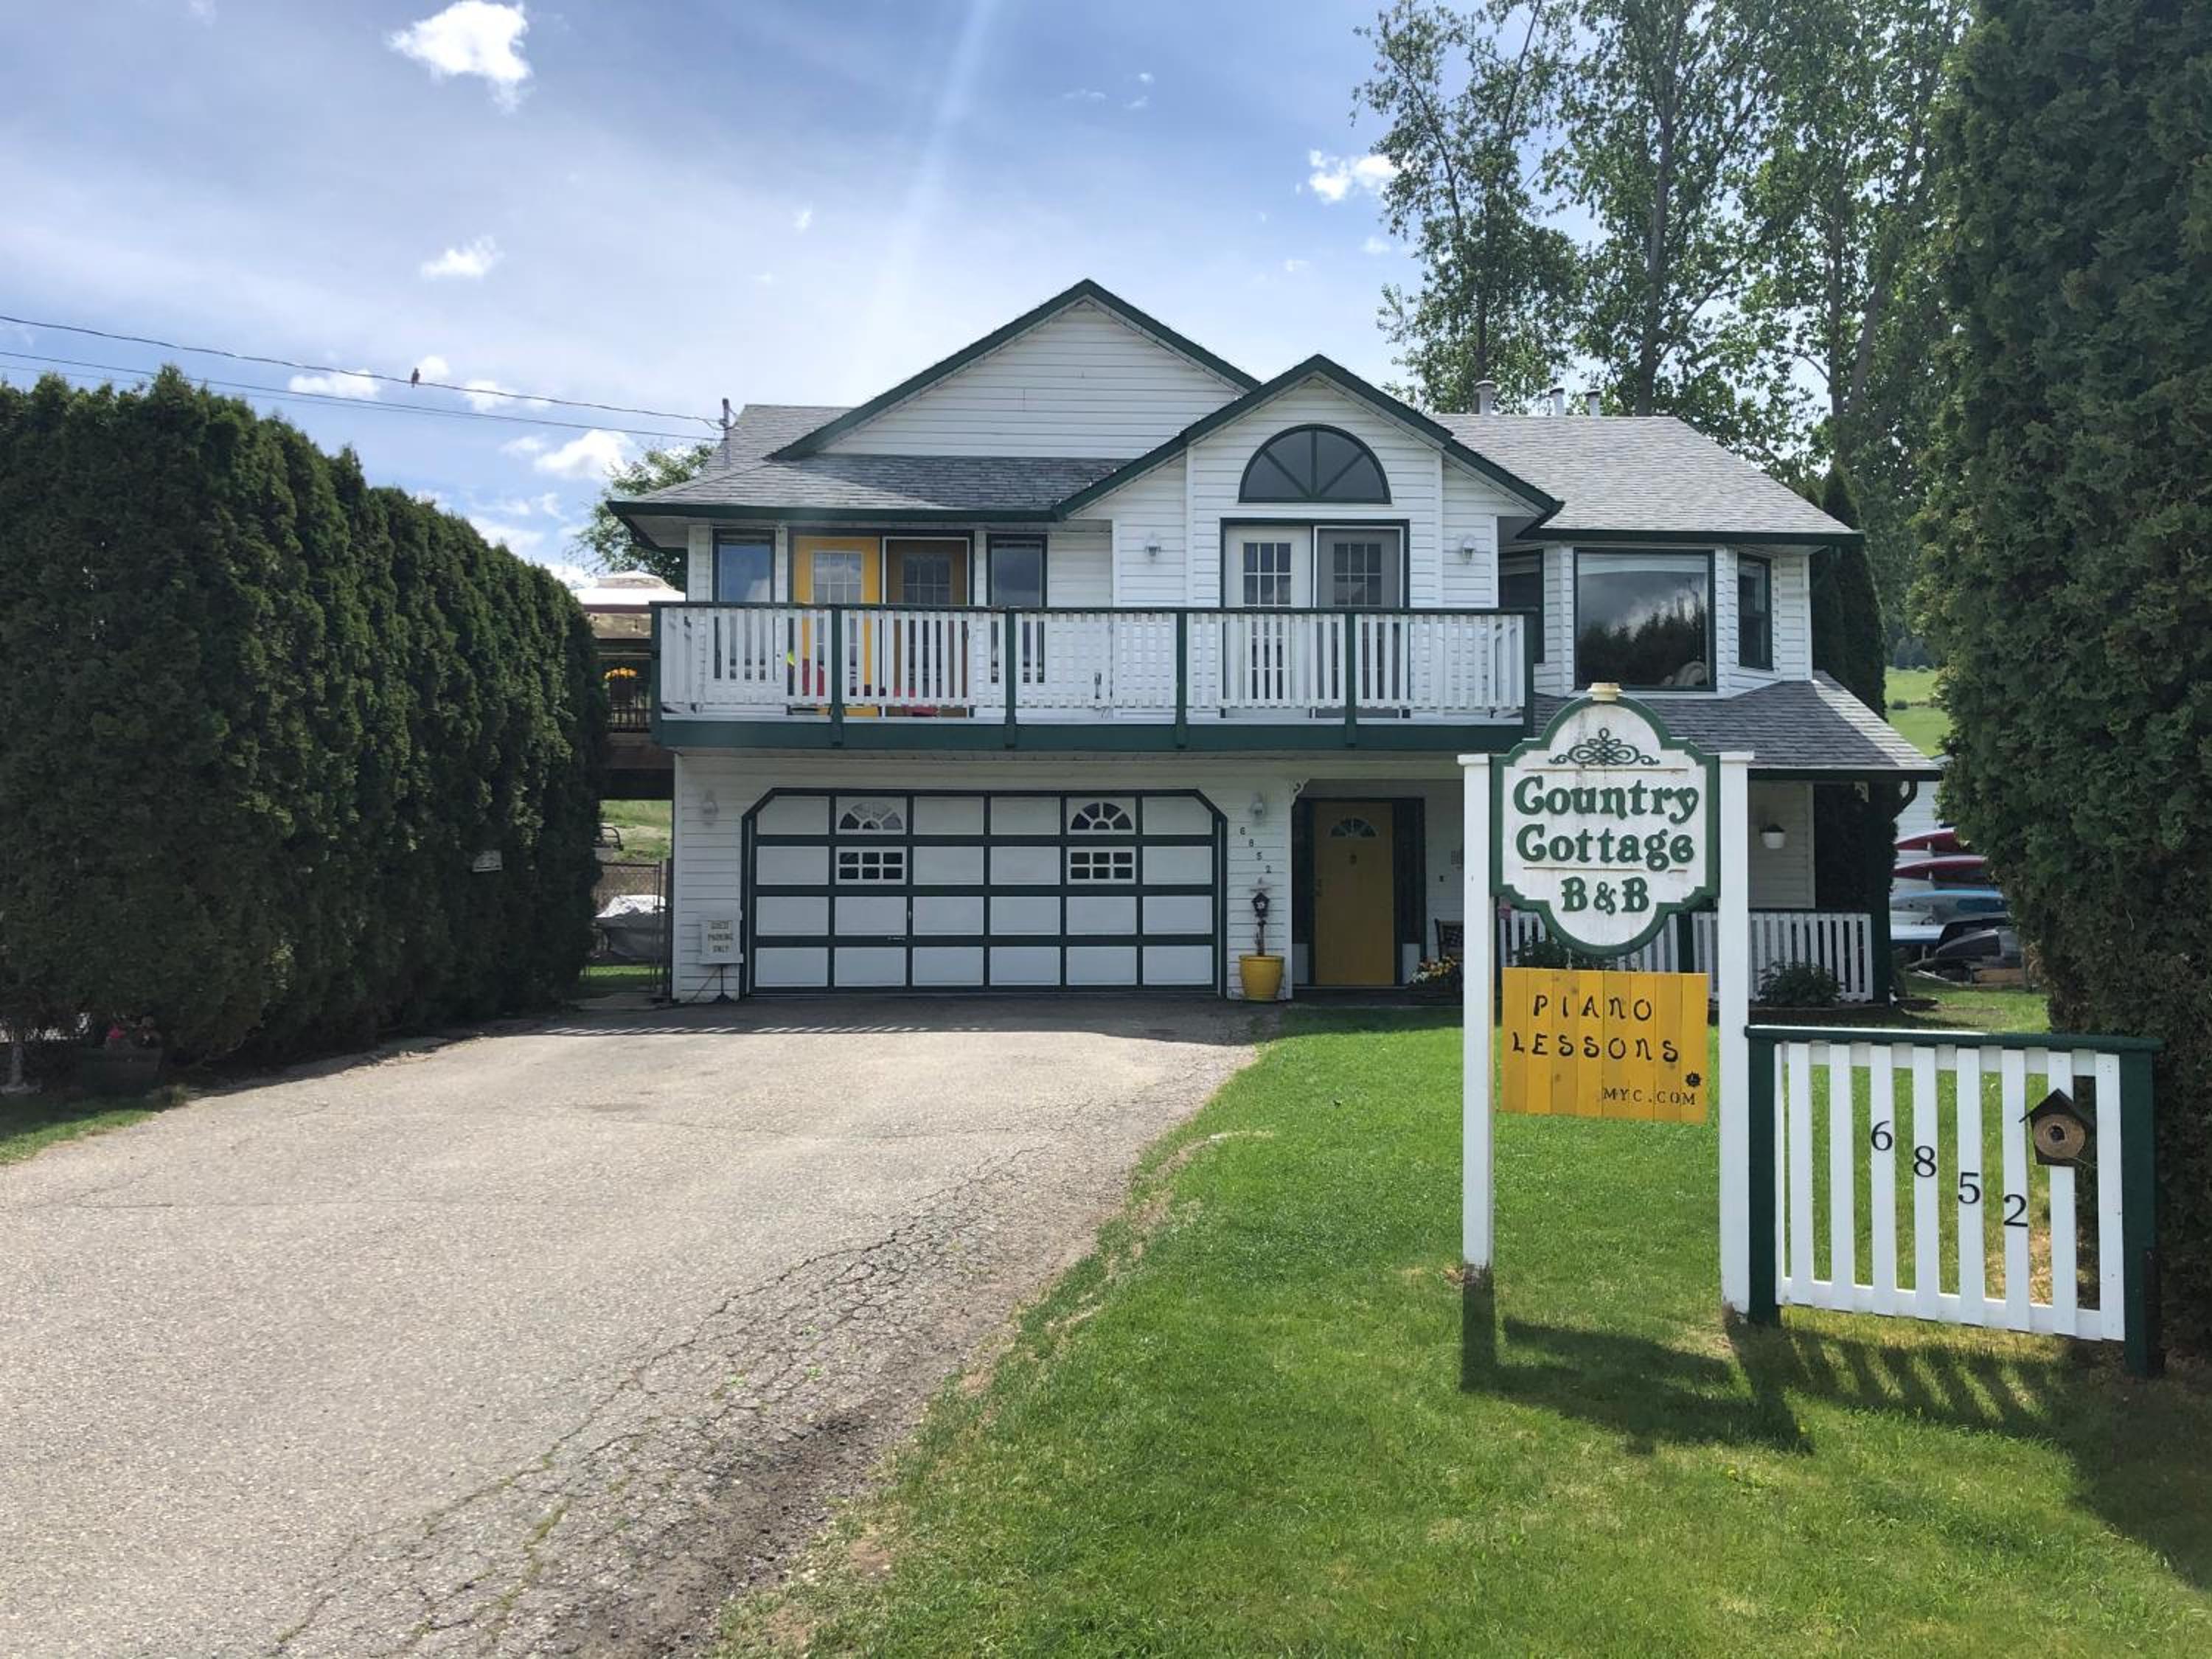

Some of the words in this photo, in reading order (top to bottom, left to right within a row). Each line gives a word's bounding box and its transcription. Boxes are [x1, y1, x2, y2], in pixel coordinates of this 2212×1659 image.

[1513, 775, 1699, 824] Country
[1516, 824, 1694, 872] Cottage
[1561, 876, 1649, 915] B&B
[1533, 995, 1652, 1021] PIANO
[1512, 1032, 1679, 1062] LESSONS
[1604, 1088, 1696, 1105] MYC.COM
[1871, 1120, 2028, 1228] 6852
